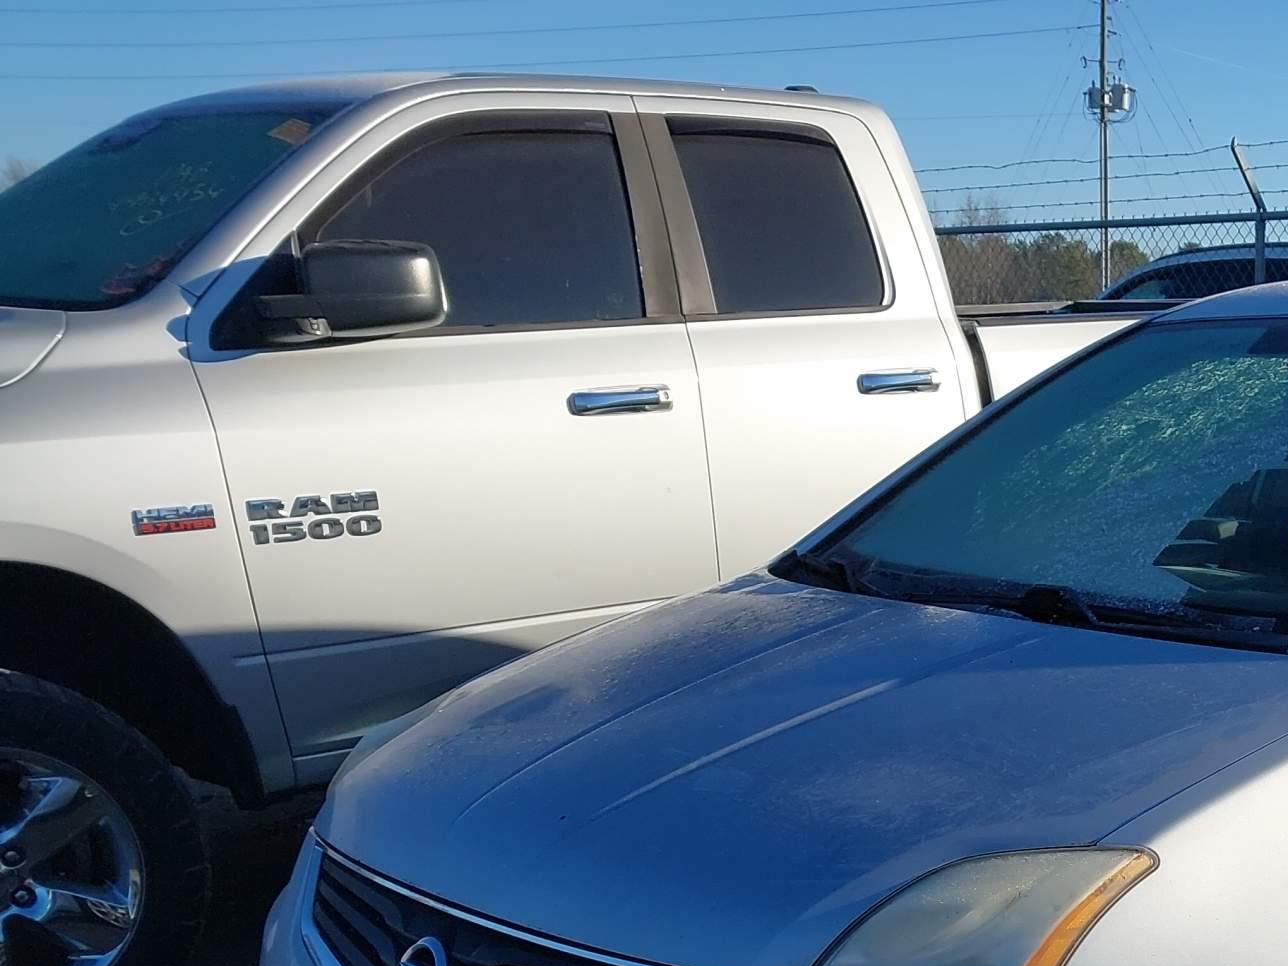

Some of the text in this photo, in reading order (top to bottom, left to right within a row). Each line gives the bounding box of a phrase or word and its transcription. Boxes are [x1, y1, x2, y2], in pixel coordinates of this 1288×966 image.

[131, 503, 214, 525] HEMI
[246, 490, 380, 521] RAM
[249, 514, 382, 545] 1500
